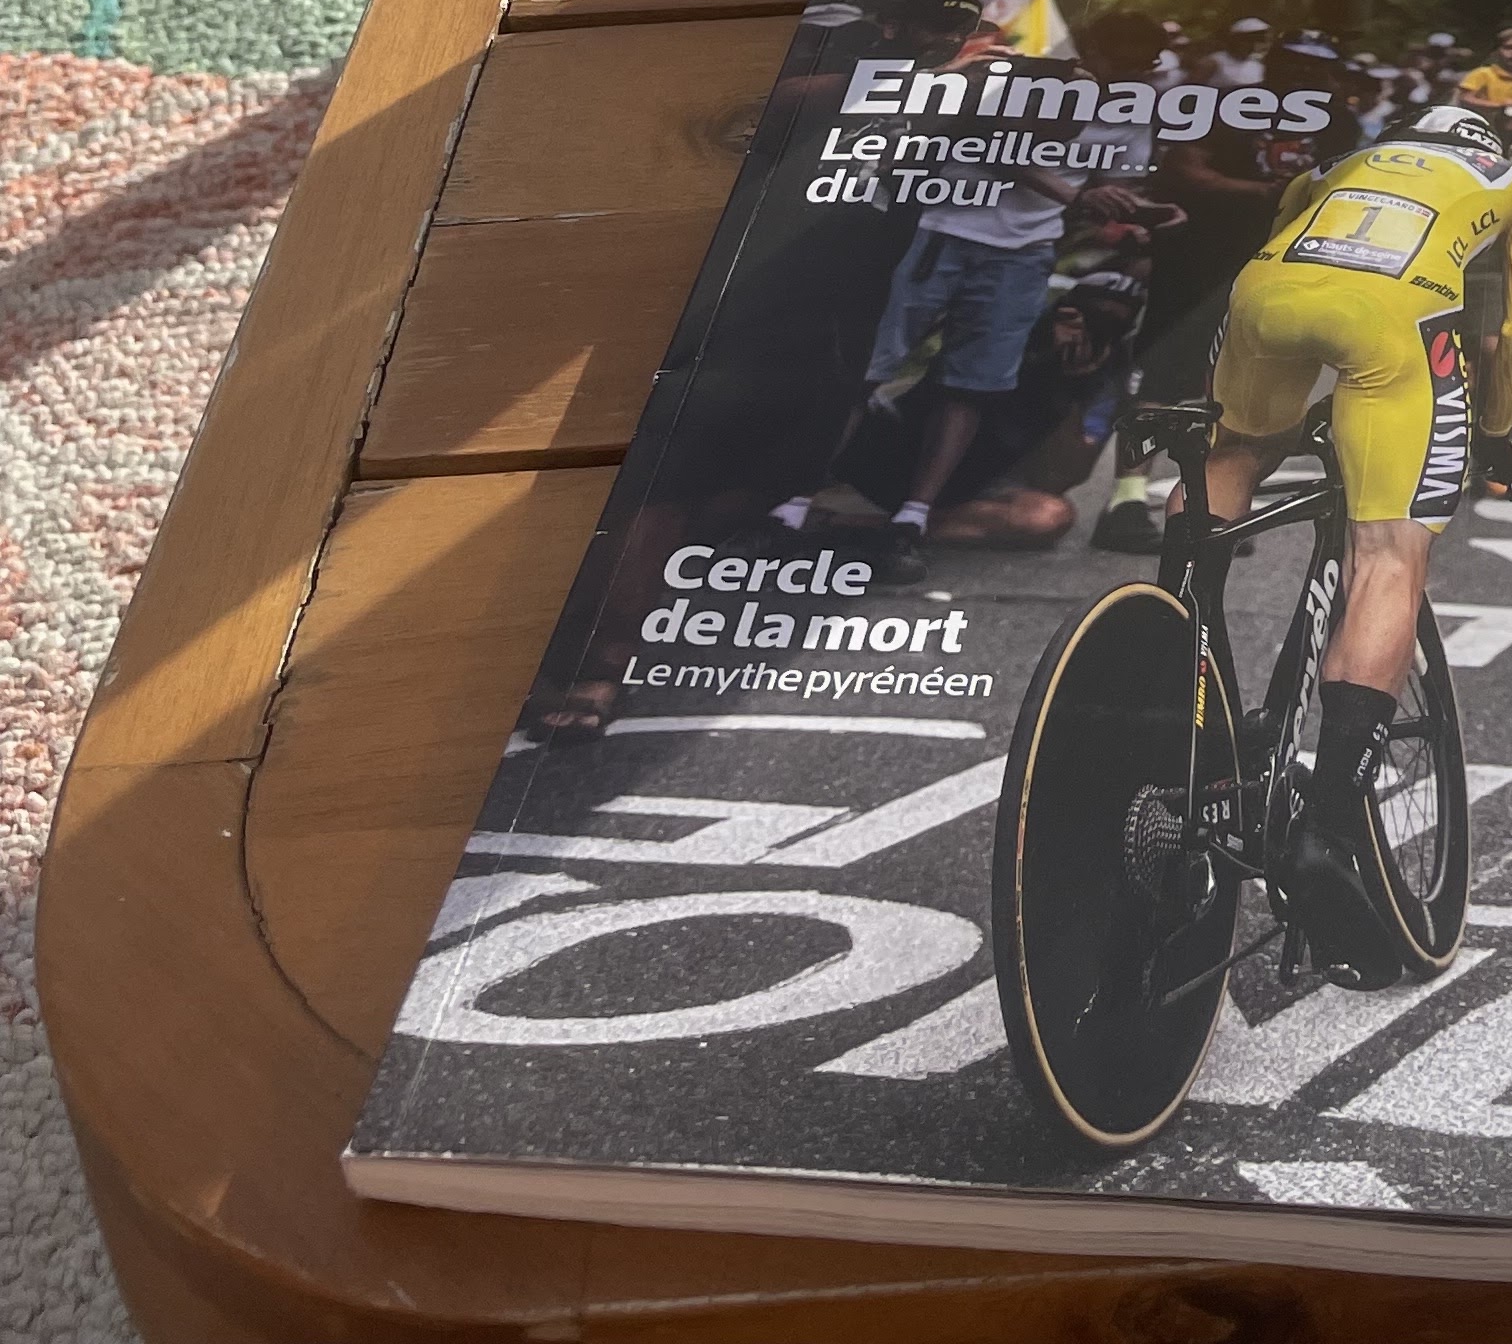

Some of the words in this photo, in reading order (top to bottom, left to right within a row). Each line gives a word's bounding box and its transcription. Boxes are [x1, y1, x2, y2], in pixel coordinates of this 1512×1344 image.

[838, 58, 967, 117] En
[976, 60, 1334, 142] images
[819, 126, 887, 162] Le
[891, 130, 1159, 174] meilleur...
[1371, 153, 1435, 173] LCL
[804, 167, 880, 204] du
[891, 168, 1016, 208] Tour
[1345, 205, 1384, 242] 1
[1471, 209, 1500, 236] LCL
[1446, 236, 1469, 268] LCL
[1416, 385, 1468, 503] VISMA
[662, 543, 873, 597] Cercle
[639, 597, 726, 647] de
[732, 601, 797, 649] la
[801, 610, 970, 654] mort
[620, 655, 673, 688] Le
[673, 662, 803, 697] mythe
[802, 664, 995, 701] pyrénéen
